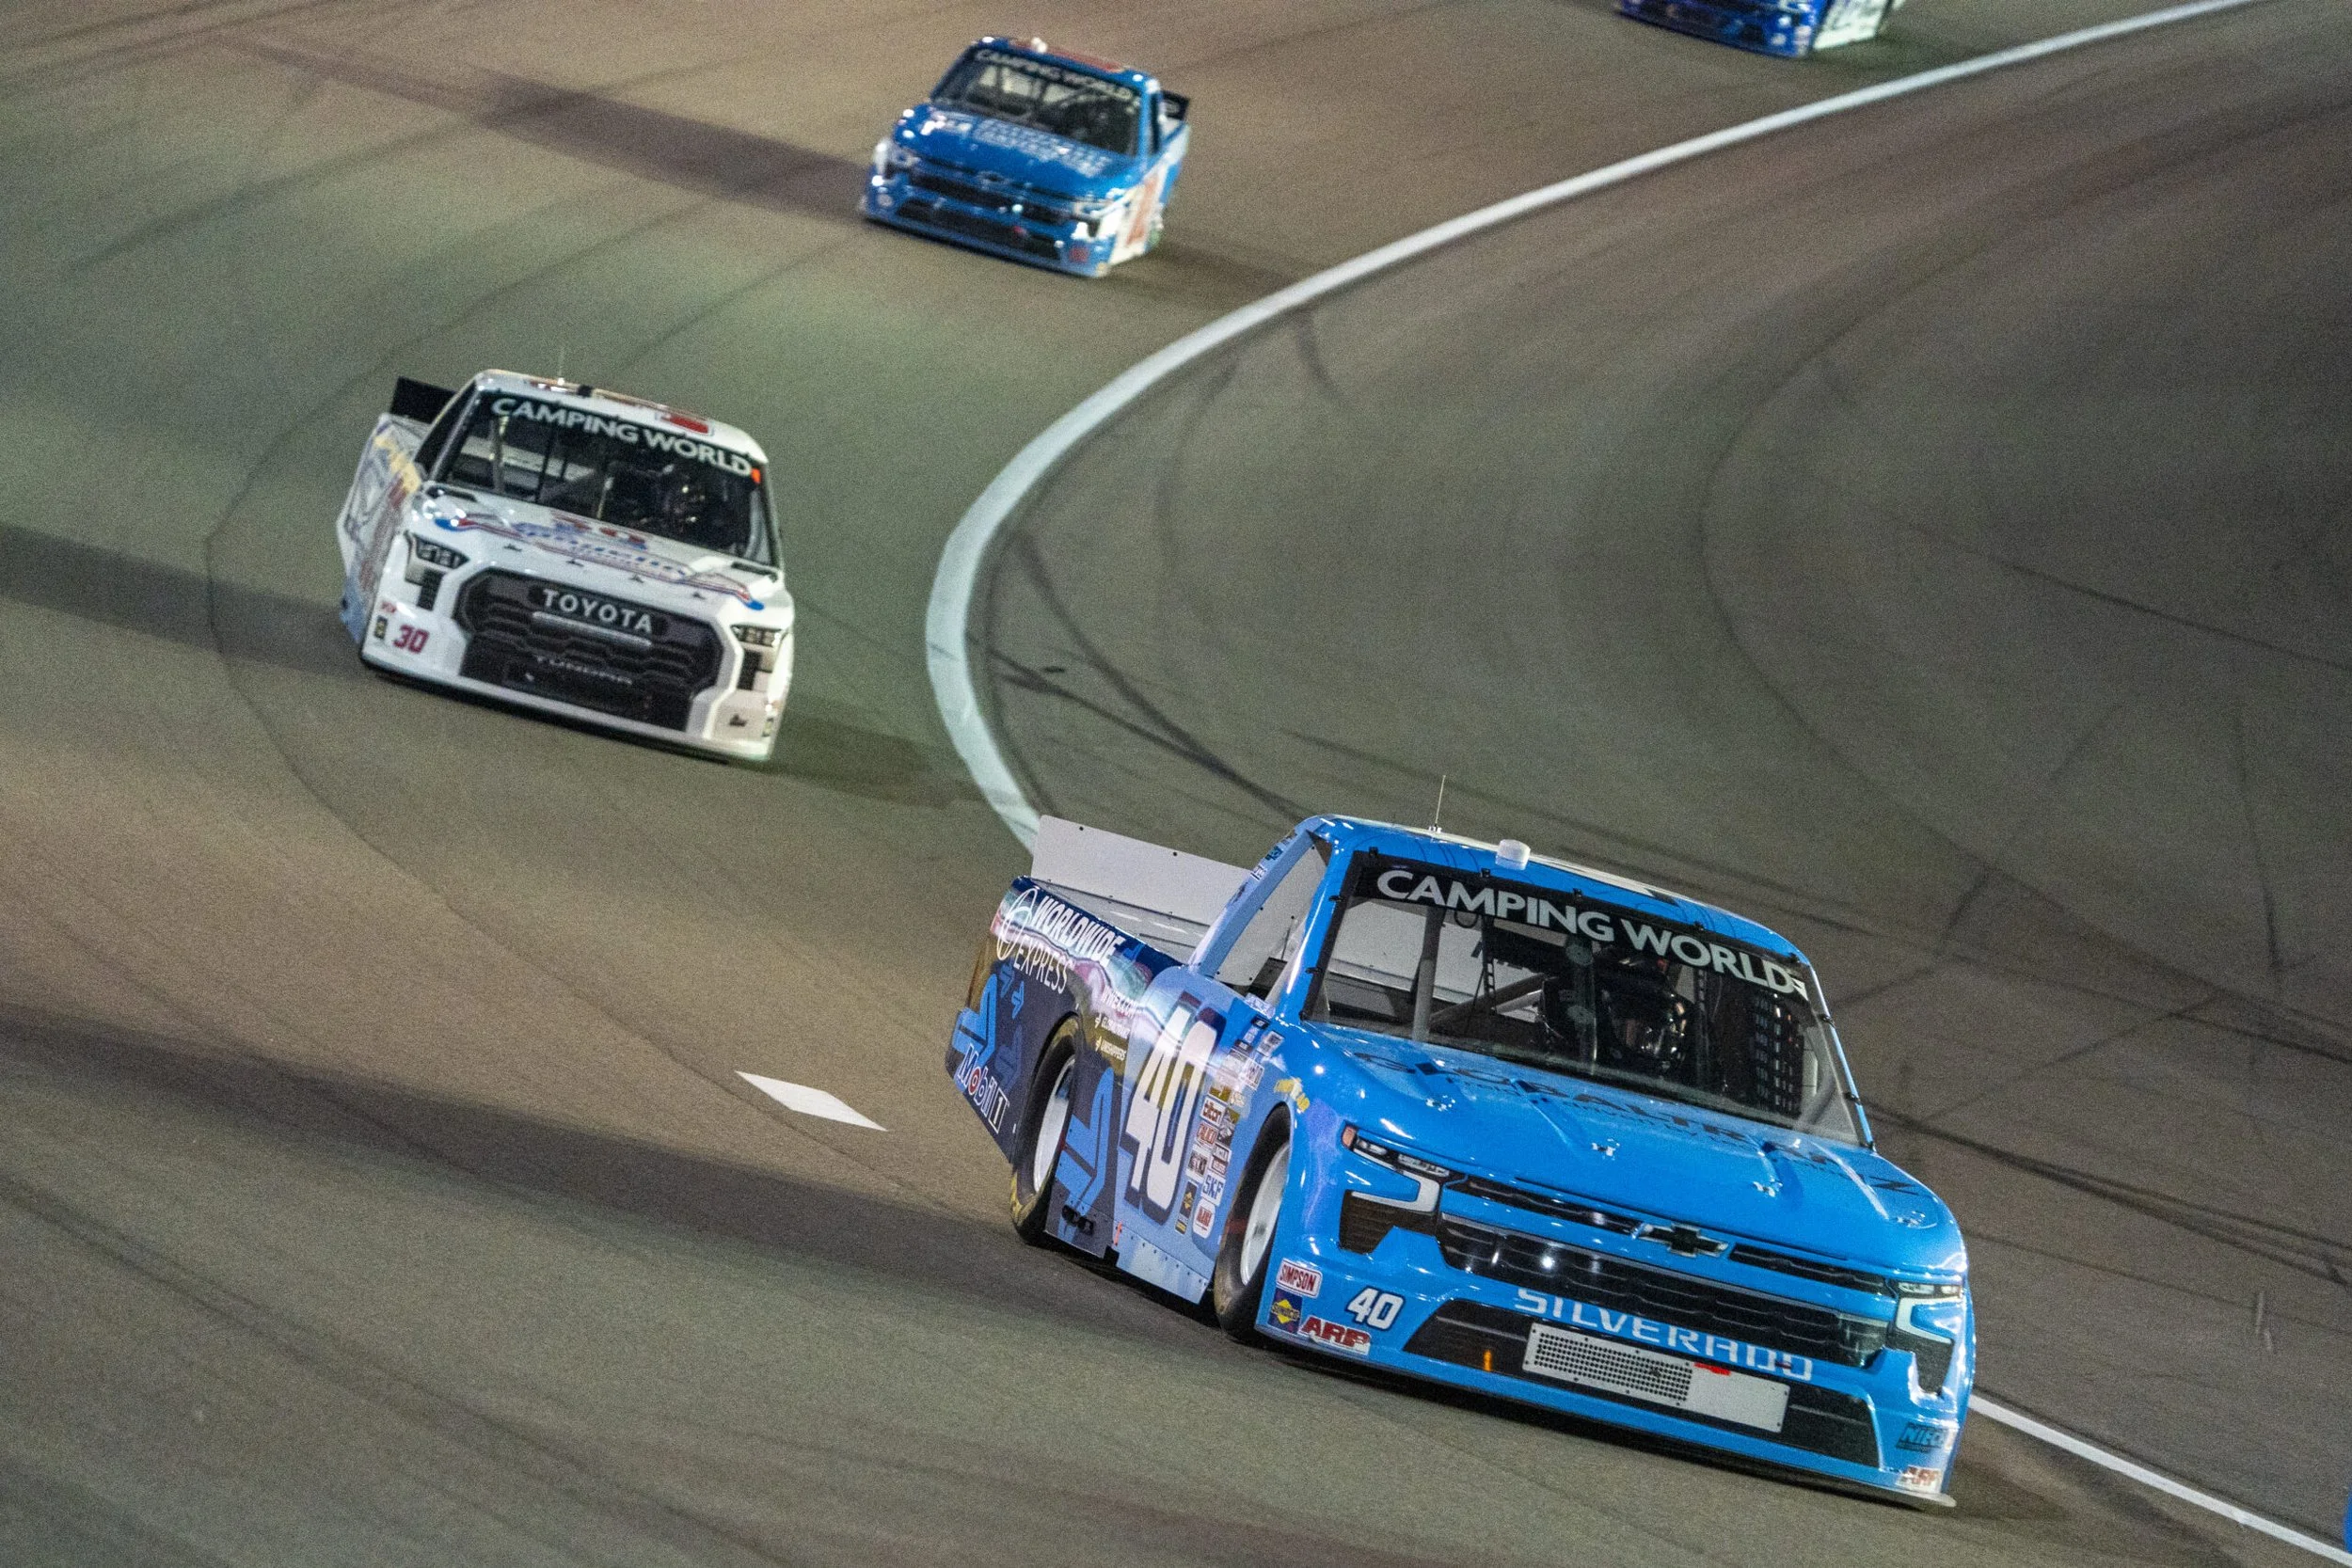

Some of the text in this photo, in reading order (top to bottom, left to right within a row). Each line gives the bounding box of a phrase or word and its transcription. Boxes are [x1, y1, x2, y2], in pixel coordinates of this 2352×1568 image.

[491, 398, 753, 478] CAMPING WORLD
[393, 625, 430, 655] 30
[543, 588, 653, 634] TOYOTA
[1030, 895, 1127, 968] WORLDWIDE
[1377, 870, 1796, 994] CAMPING WORLD
[1013, 934, 1075, 994] EXPRESS
[958, 1042, 997, 1118] Mobil
[1124, 1005, 1218, 1212] 40
[1202, 1173, 1223, 1200] SKF
[1279, 1264, 1317, 1291] SIMPSON
[1299, 1316, 1371, 1347] ARP
[1346, 1287, 1405, 1330] 40
[1515, 1287, 1813, 1381] SILVERADO
